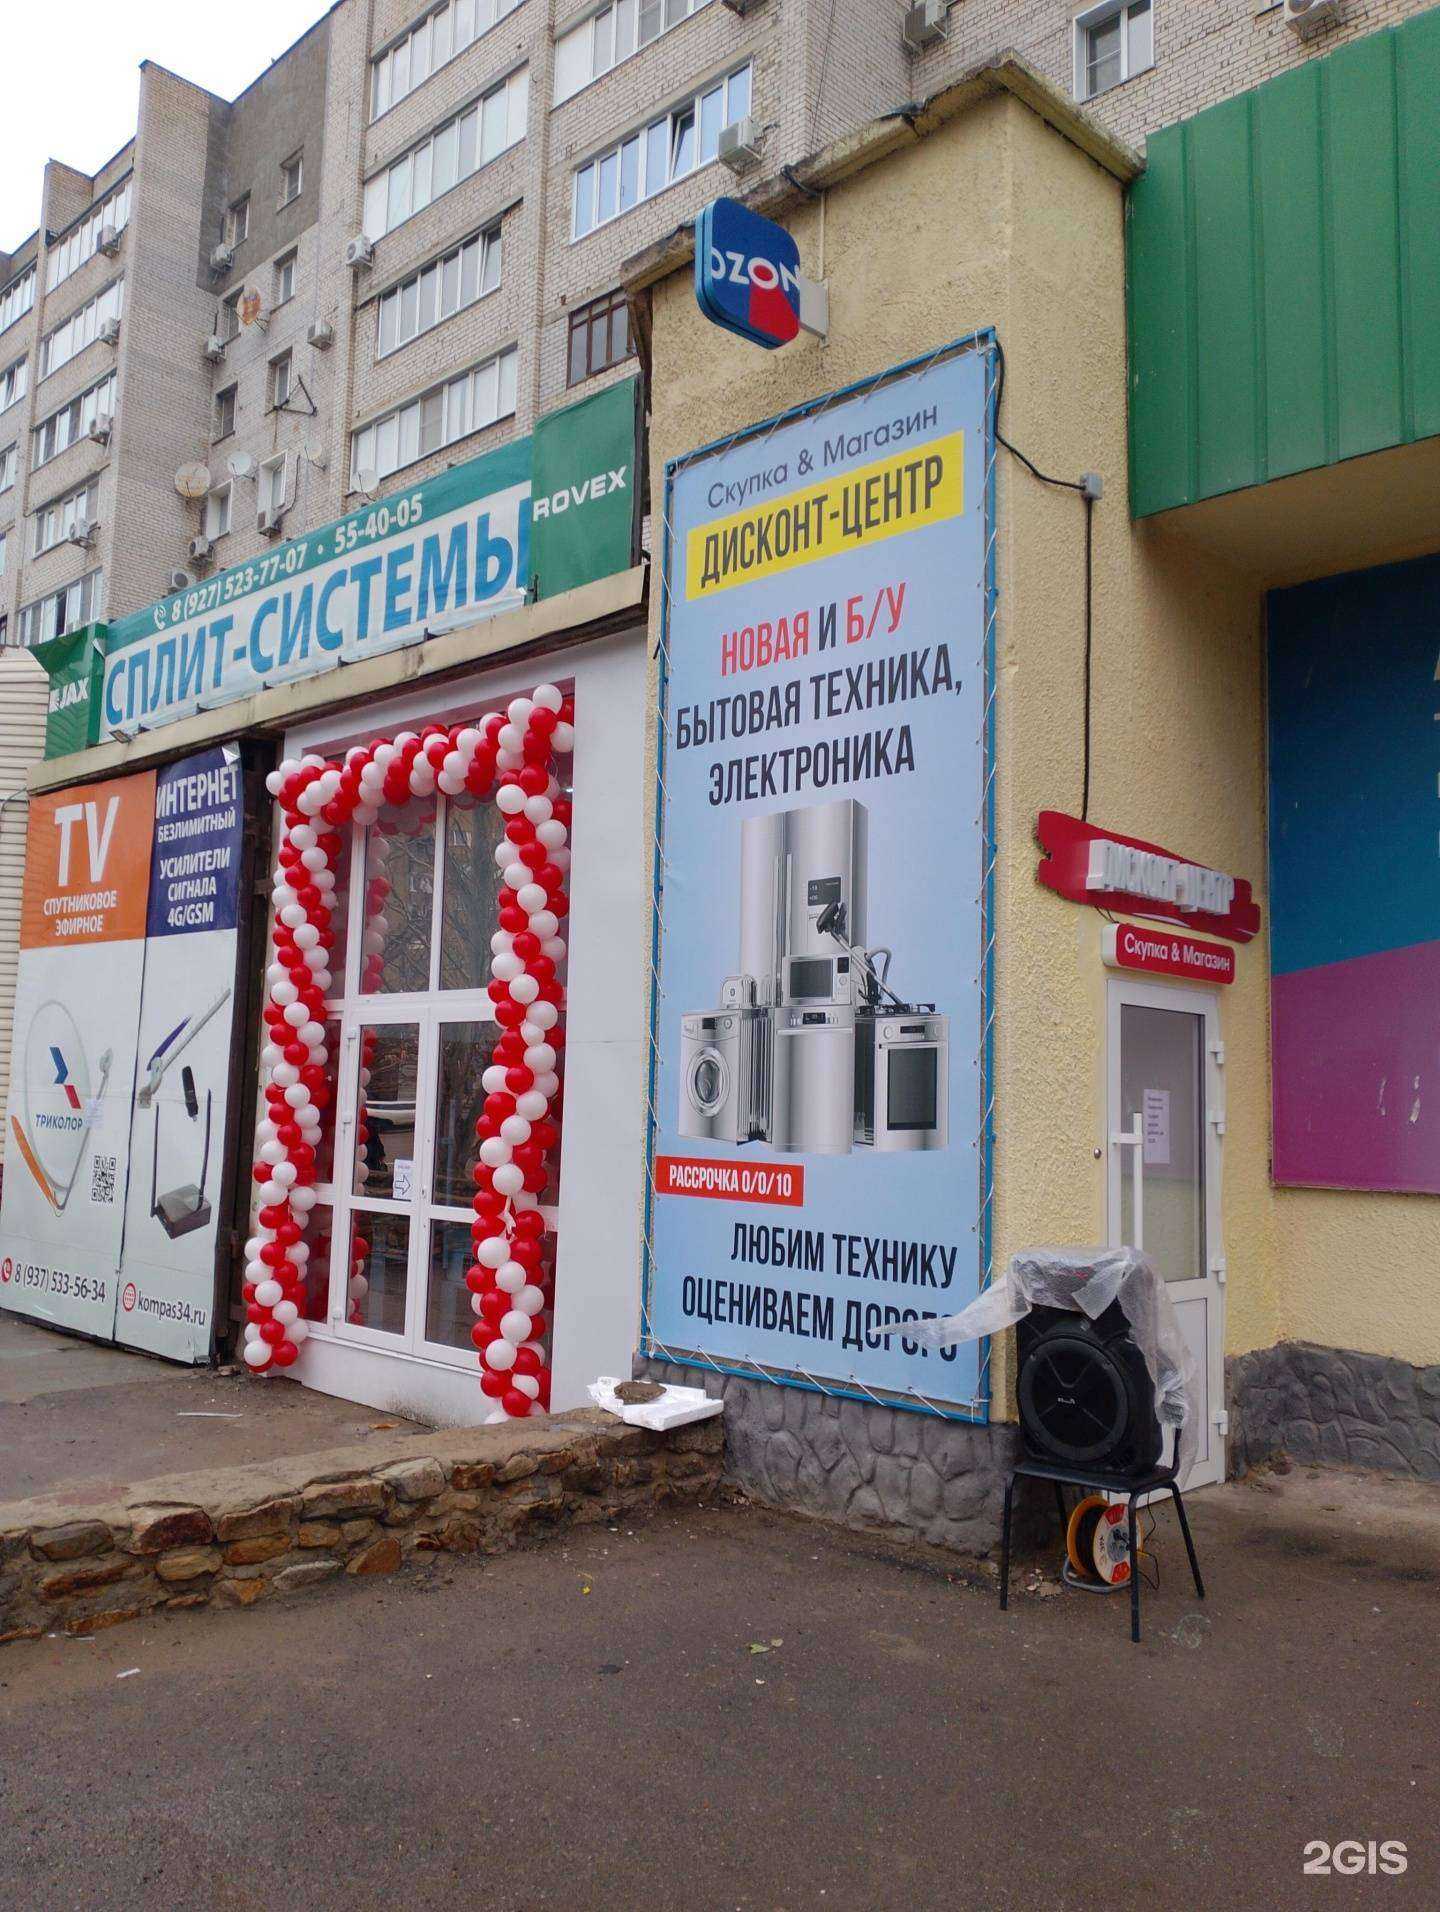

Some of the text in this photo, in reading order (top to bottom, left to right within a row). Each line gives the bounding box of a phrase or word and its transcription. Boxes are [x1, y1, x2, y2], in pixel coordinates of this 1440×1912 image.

[707, 405, 938, 509] Скупка & Магазин
[533, 465, 627, 522] ROVEX
[701, 454, 944, 589] ДИСКОНТ-ЦЕНТР
[171, 493, 423, 622] 8 (927) 523-77-07 55-40-05
[105, 496, 532, 726] СПЛИТ-СИСТЕМЫ
[721, 582, 906, 677] НОВАЯ И Б/У
[676, 643, 963, 750] БЫТОВАЯ ТЕХНИКА,
[156, 765, 239, 819] ИНТЕРНЕТ
[709, 724, 915, 806] ЭЛЕКТРОНИКА
[54, 796, 121, 887] TV
[157, 807, 236, 843] БЕЗЛИМИТНЫЙ
[160, 847, 231, 880] УСИЛИТЕЛИ
[168, 876, 217, 902] СИГНАЛА
[43, 890, 118, 916] СПУТНИКОВОЕ
[55, 914, 104, 937] ЭФИРНОЕ
[167, 901, 214, 927] 4G/GSM
[1124, 932, 1230, 971] Скупка & Магазин
[36, 1113, 84, 1132] ТРИКОЛОР
[669, 1164, 792, 1198] РАССРОЧКА 0/0/10
[14, 1263, 106, 1302] 8 (937) 533-56-34
[731, 1222, 958, 1289] ЛЮБИМ ТЕХНИКУ
[138, 1290, 206, 1326] kompas34.ru
[682, 1275, 834, 1342] ОЦЕНИВАЕМ
